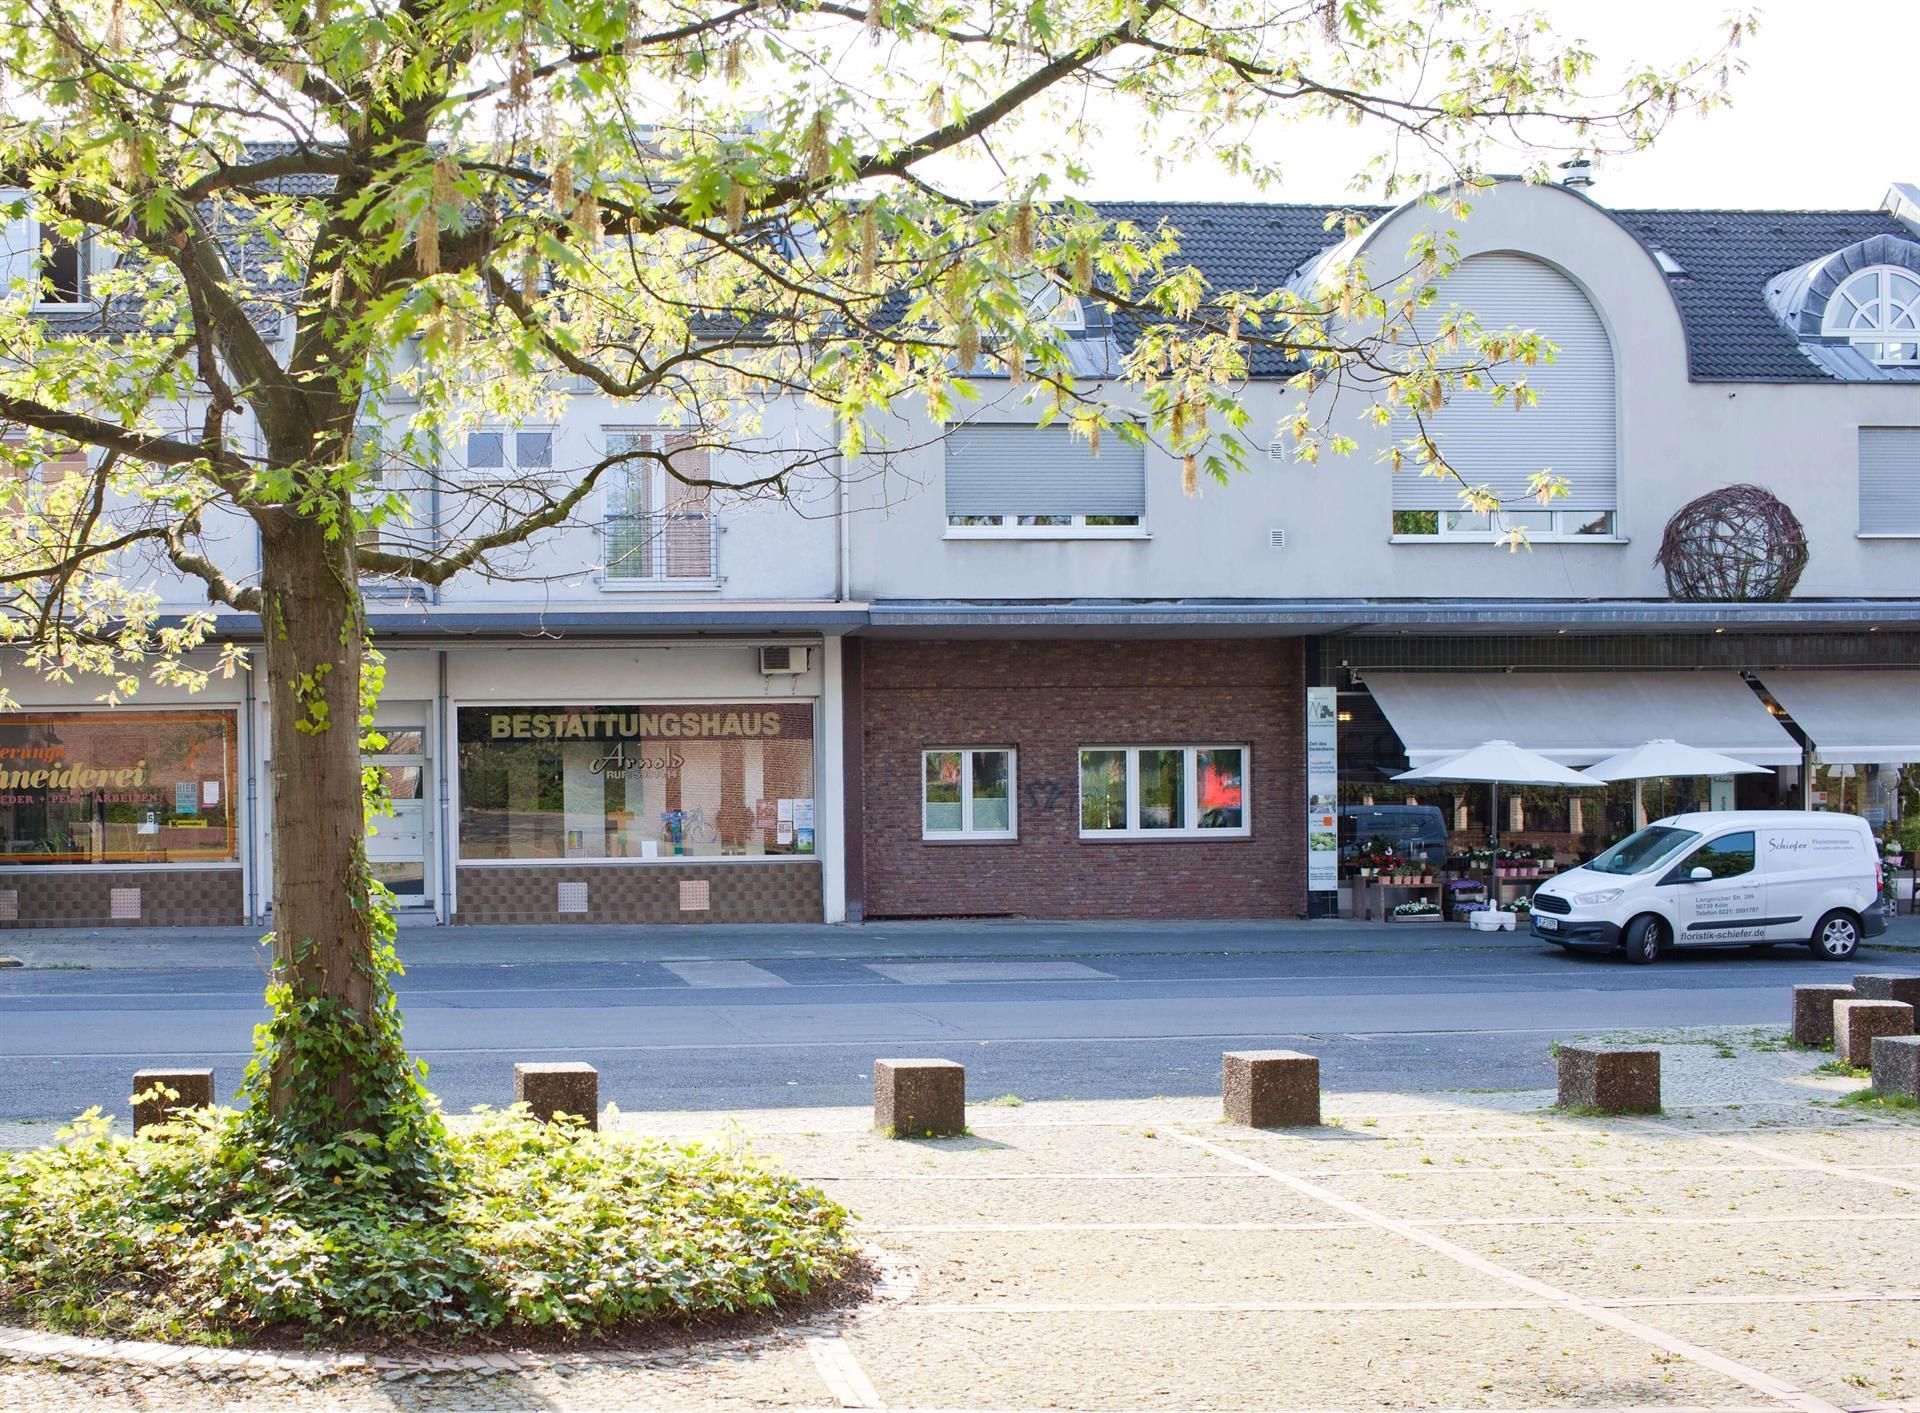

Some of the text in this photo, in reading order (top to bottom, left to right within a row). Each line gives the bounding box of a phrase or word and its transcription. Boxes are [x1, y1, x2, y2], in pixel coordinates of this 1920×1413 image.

[491, 713, 781, 738] BESTATTUNGSHAUS
[589, 742, 685, 775] Arnold
[1768, 837, 1808, 853] Schiefer
[1680, 928, 1766, 941] floristik-schiefer.de
